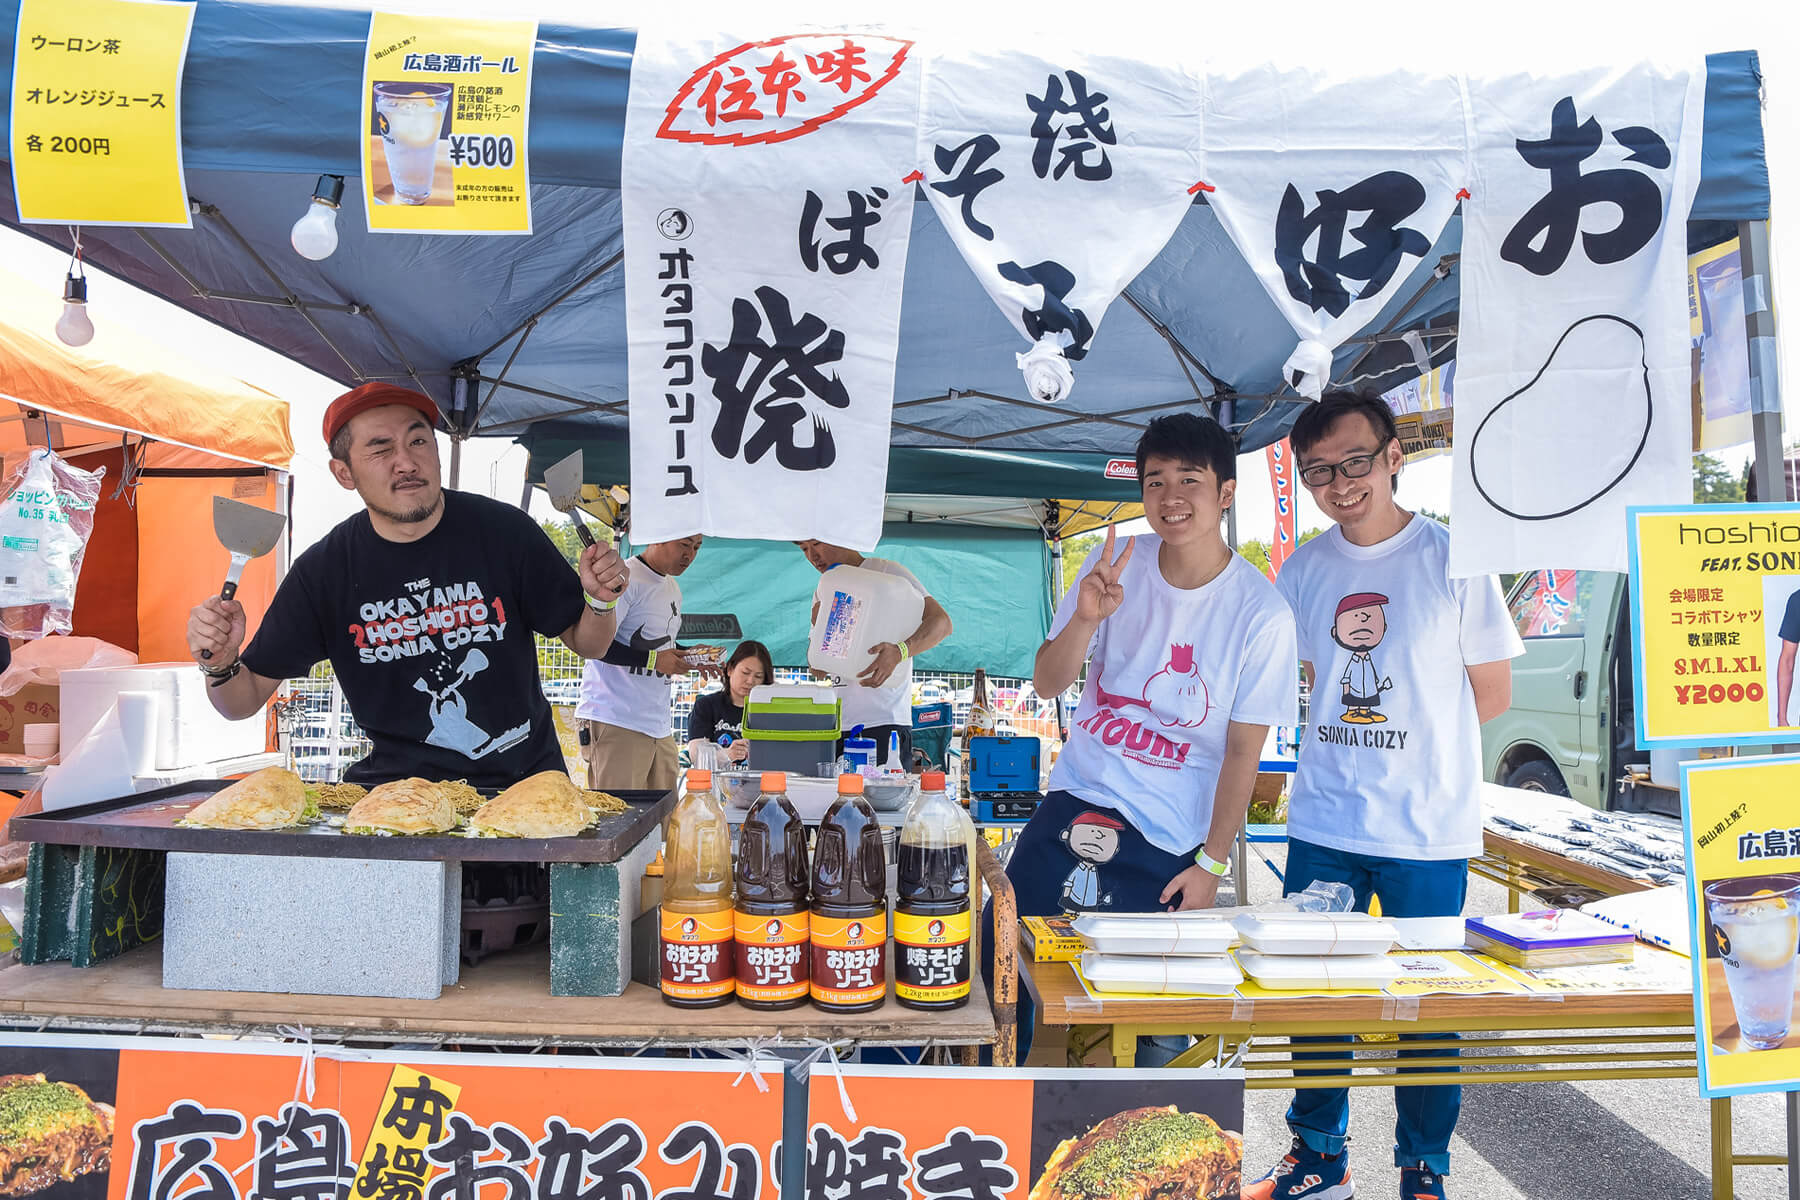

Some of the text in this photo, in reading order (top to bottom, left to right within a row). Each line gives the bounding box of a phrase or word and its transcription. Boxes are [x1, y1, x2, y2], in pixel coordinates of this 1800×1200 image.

[31, 35, 121, 54] ウーロン茶
[403, 54, 519, 73] 広島酒ボール
[27, 88, 166, 109] オレンジジュース
[27, 135, 110, 155] 各 200円
[450, 136, 513, 167] ¥500
[1500, 96, 1671, 276] お
[18, 507, 44, 519] No.35
[1701, 557, 1742, 572] FEAT.
[404, 577, 431, 592] THE
[359, 581, 484, 622] OKAYAMA
[1669, 588, 1724, 603] 会場限定
[366, 603, 489, 644] HOSHIOTO
[1671, 610, 1762, 625] コラボTシャツ
[359, 635, 438, 664] SONIA
[442, 622, 508, 650] COZY
[1688, 632, 1741, 647] 数量限定
[1674, 682, 1764, 704] ¥2000
[1318, 725, 1408, 750] SONIA COZY
[1697, 803, 1748, 849] 岡山初上陸？
[666, 944, 719, 964] お好み
[747, 945, 801, 966] お好み
[826, 948, 880, 970] お好み
[906, 945, 964, 968] 焼そば
[671, 963, 711, 983] ソース
[755, 965, 795, 985] ソース
[835, 968, 874, 988] ソース
[918, 967, 958, 986] ソース
